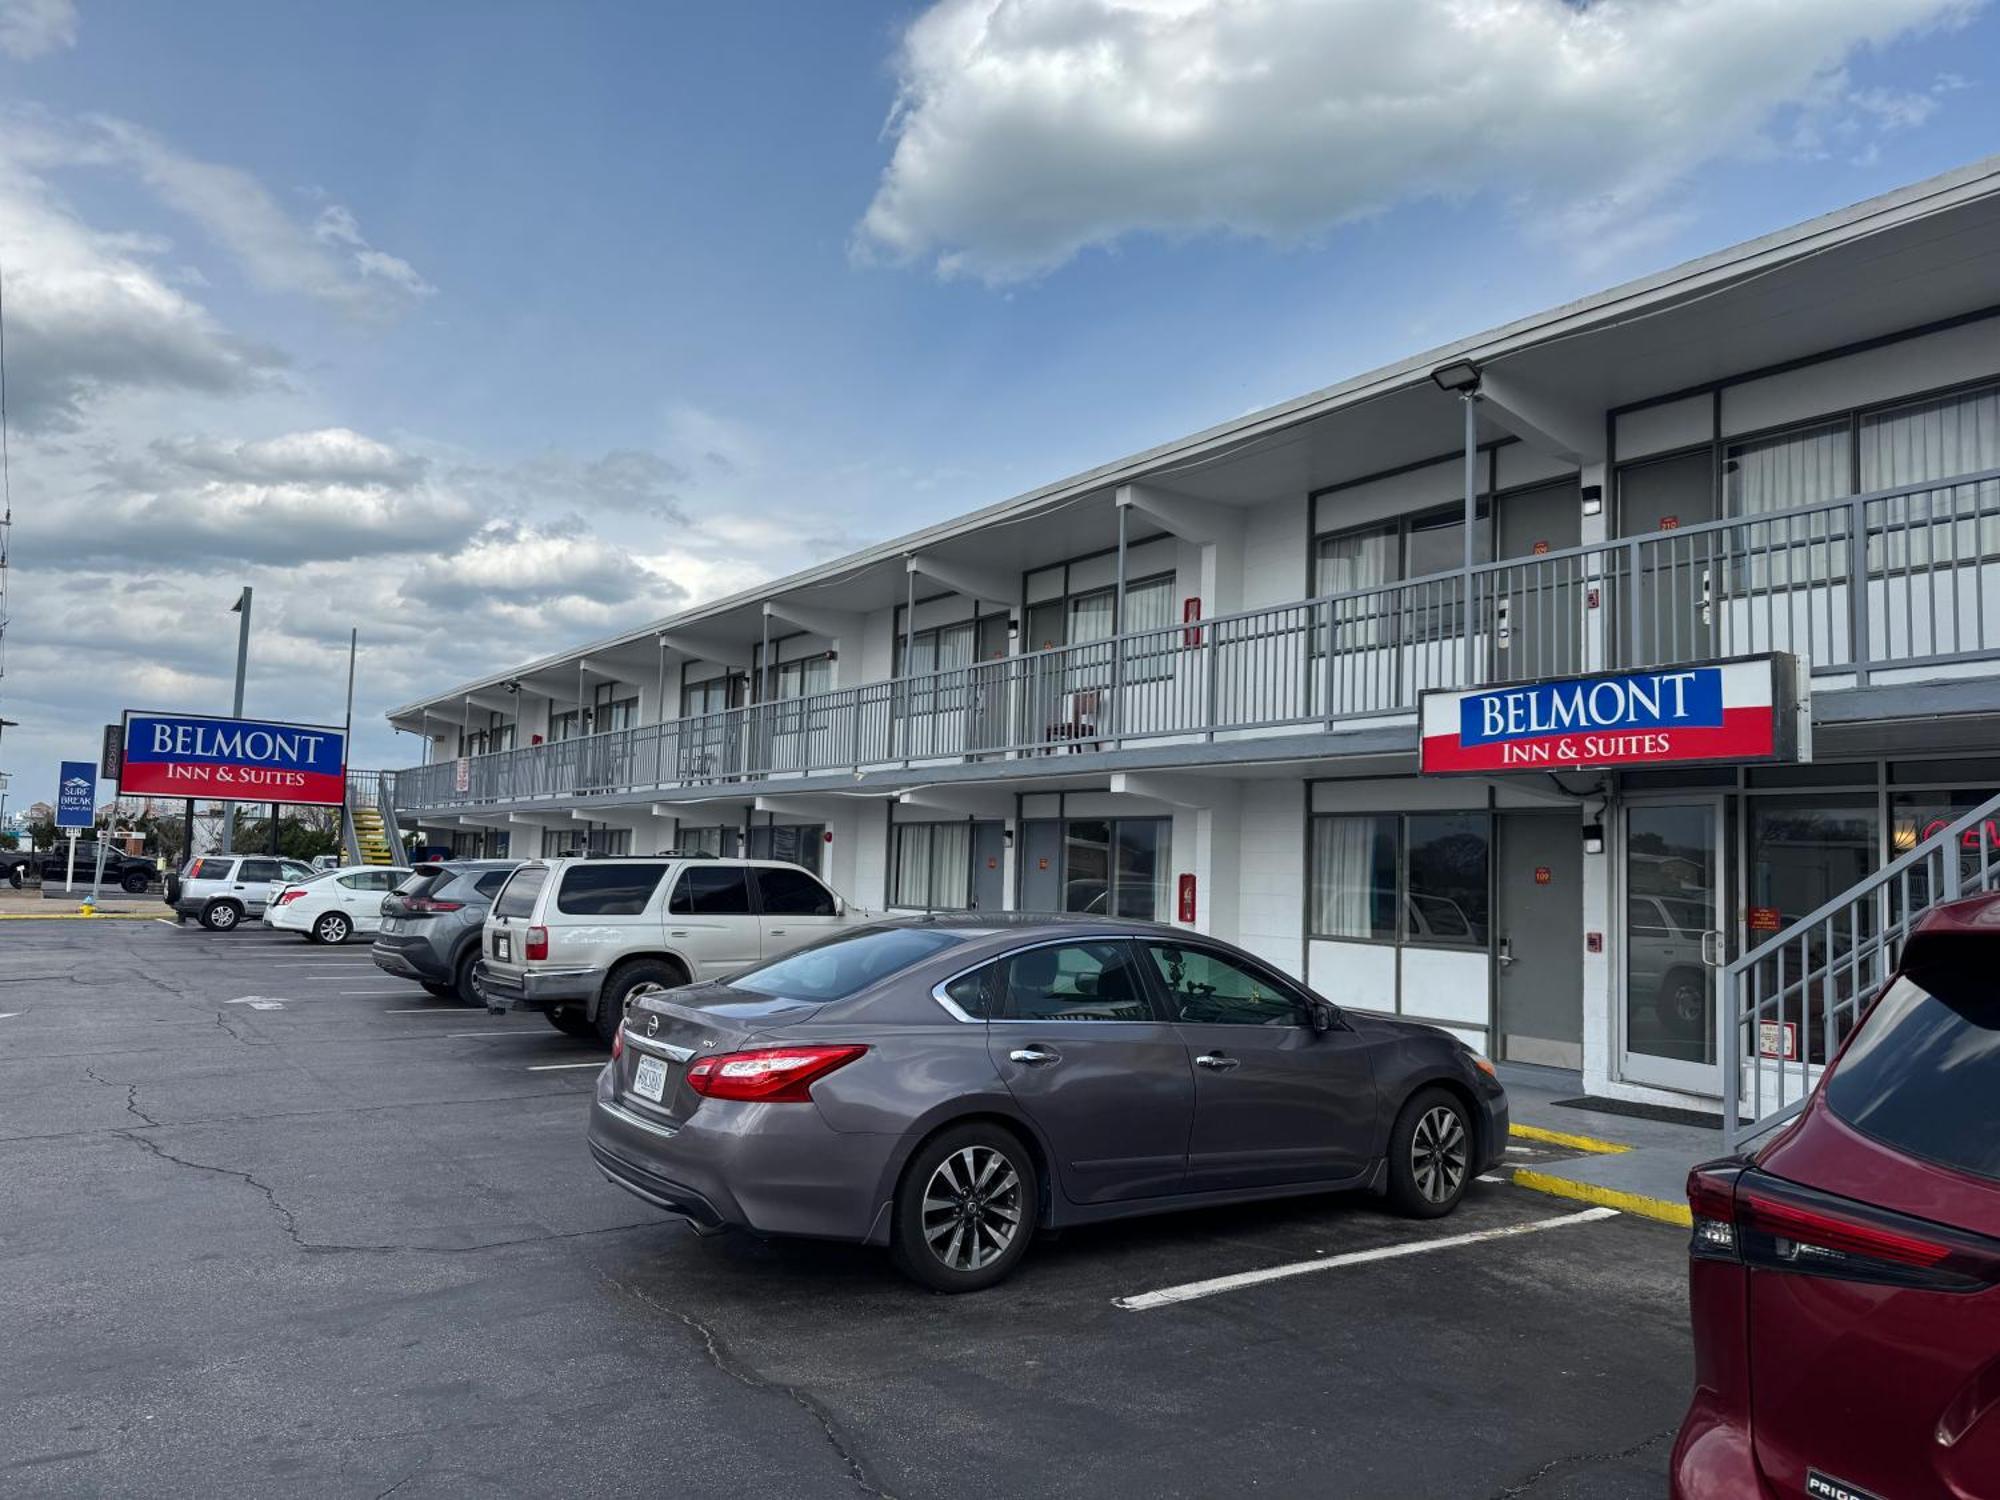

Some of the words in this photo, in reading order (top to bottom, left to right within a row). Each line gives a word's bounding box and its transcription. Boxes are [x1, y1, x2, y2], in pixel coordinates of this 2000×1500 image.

[1480, 672, 1696, 737] BELMONT
[152, 723, 324, 764] BELMONT
[1503, 742, 1550, 764] INN
[1556, 738, 1578, 760] &
[1583, 733, 1670, 759] SUITES
[167, 763, 212, 781] INN
[216, 766, 235, 782] &
[238, 768, 305, 786] SUITES
[61, 796, 92, 805] BREAK
[64, 787, 90, 796] SURF
